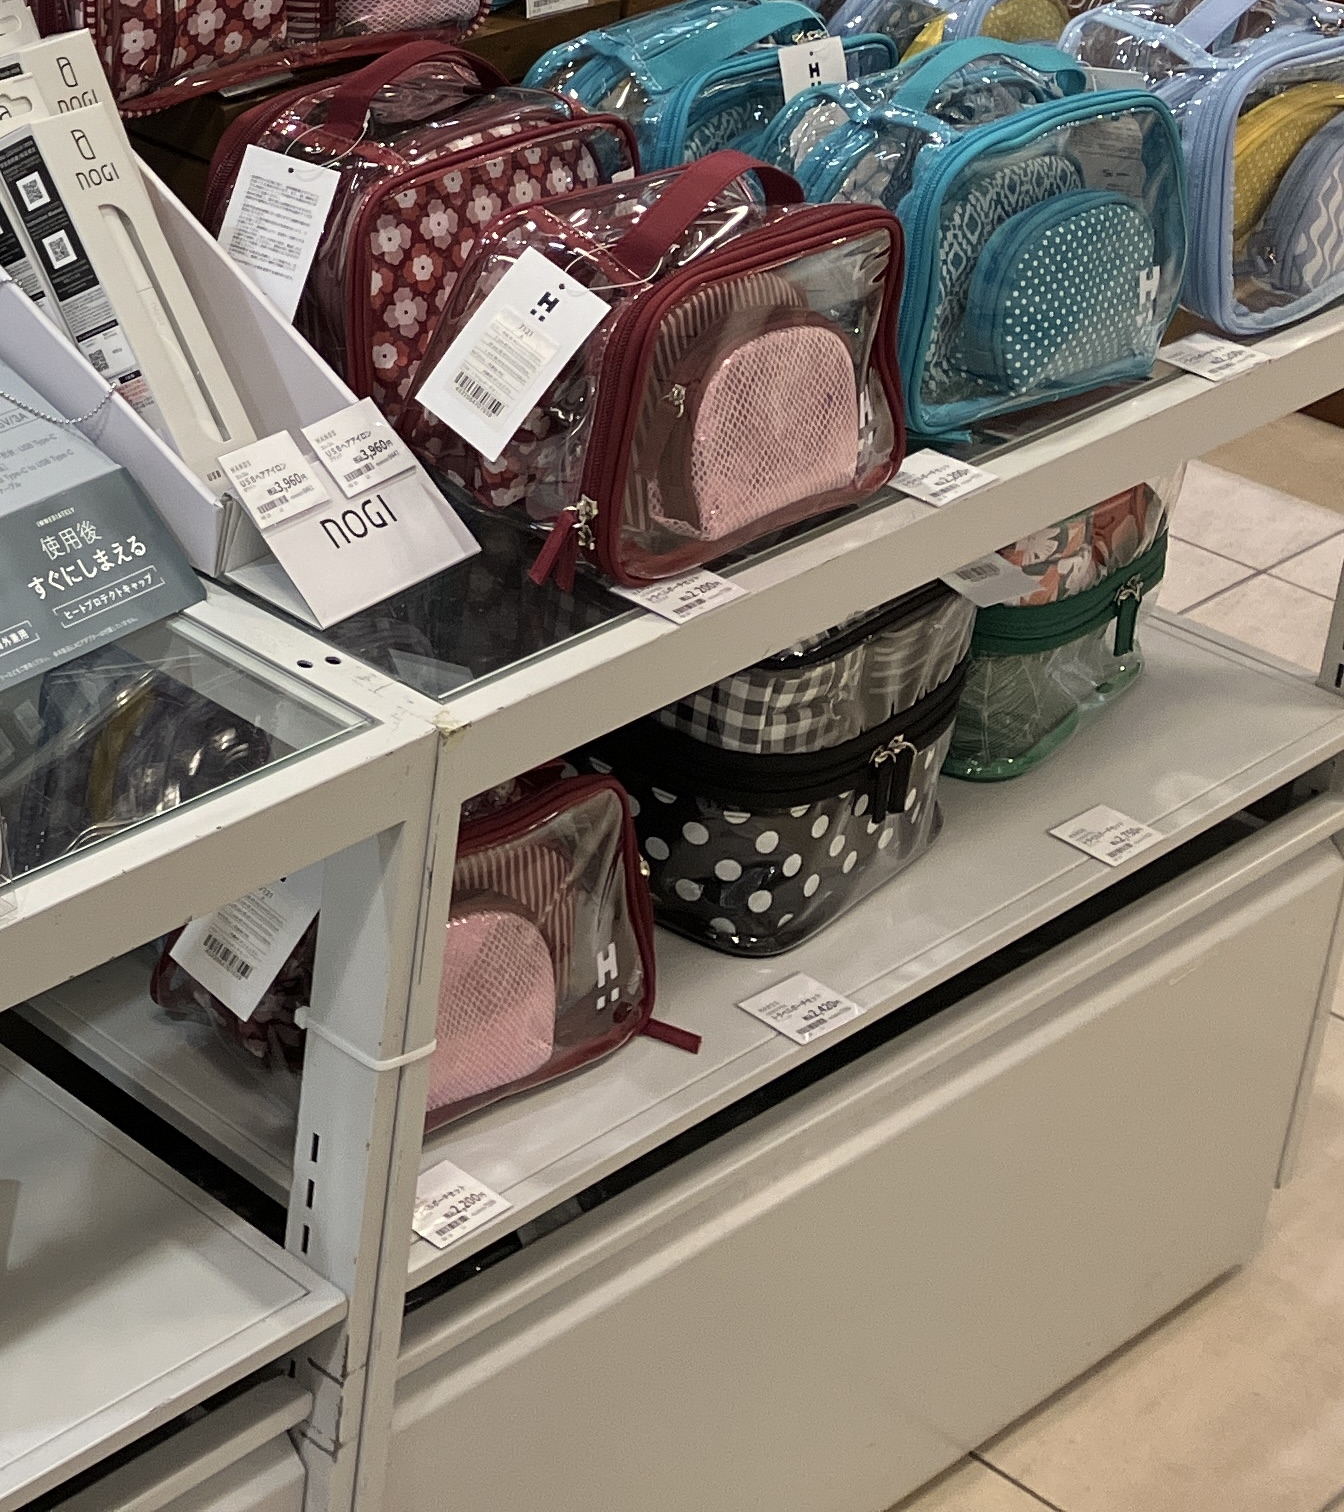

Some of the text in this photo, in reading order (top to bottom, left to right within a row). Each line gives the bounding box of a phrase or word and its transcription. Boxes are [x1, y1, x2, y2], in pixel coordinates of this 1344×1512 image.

[352, 439, 393, 465] 税込3,960円
[266, 472, 308, 496] 税込3,960円
[39, 521, 103, 562] 使用後
[27, 534, 149, 602] すぐにしまえる
[62, 571, 154, 622] ヒートプロテクトキャップ
